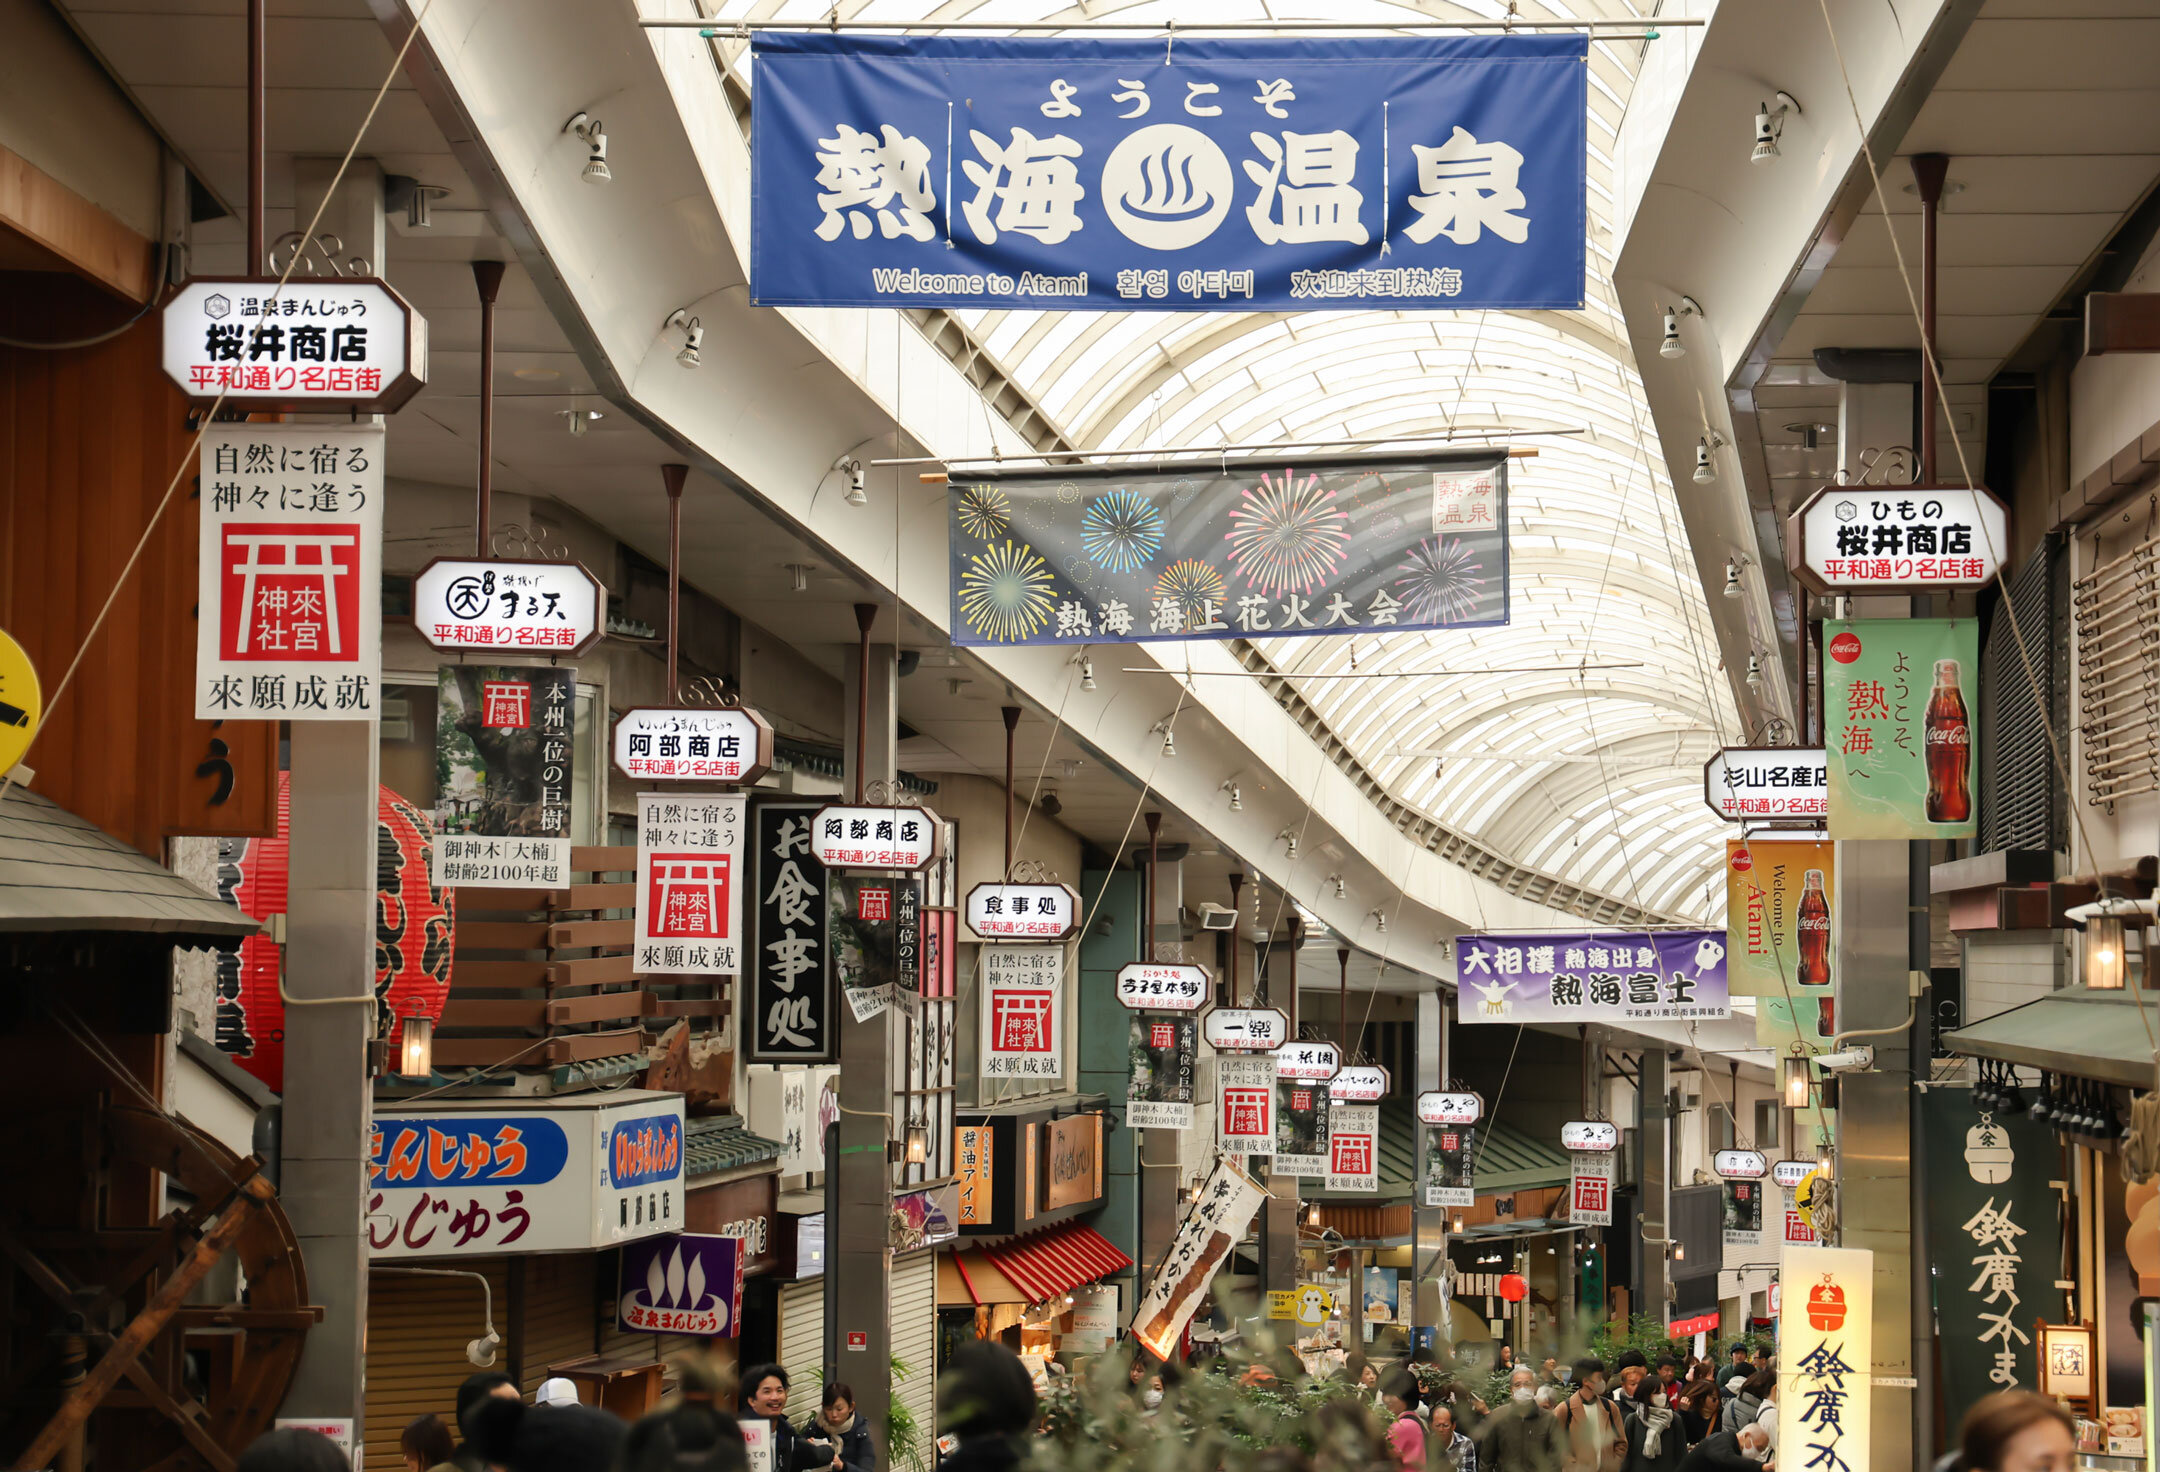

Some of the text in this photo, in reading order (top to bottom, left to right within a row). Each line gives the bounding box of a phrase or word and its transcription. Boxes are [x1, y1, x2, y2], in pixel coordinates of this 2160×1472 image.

[1041, 77, 1296, 120] ようこそ
[814, 124, 1532, 246] 熱海 温泉
[872, 268, 1089, 297] Welcome to Atami
[1116, 267, 1255, 299] 환영 아타미
[1290, 267, 1463, 298] 欢迎来到热海
[240, 297, 368, 318] 温泉まんじゅう
[204, 323, 369, 363] 桜井商店
[188, 365, 382, 392] 平和通り名店街
[214, 443, 370, 475] 自然に宿る
[210, 483, 368, 513] 神々に逢う
[1438, 477, 1492, 501] 熱海
[1438, 502, 1493, 526] 温泉
[1871, 500, 1943, 521] ひもの
[1836, 523, 1972, 556] 桜井商店
[1824, 558, 1984, 580] 平和通り名店街
[500, 591, 567, 621] まる天
[1054, 588, 1404, 638] 熱海 海上花火大会
[256, 586, 289, 651] 神社
[433, 624, 576, 646] 平和通り名店街
[1829, 642, 1861, 655] Coca-Cola
[207, 673, 371, 710] 來願成就
[1892, 651, 1917, 758] ようこそ、
[540, 682, 567, 831] 本州一位の巨樹
[629, 734, 740, 757] 阿部商店
[628, 758, 740, 776] 平和通り名店街
[645, 804, 737, 824] 自然に宿る
[645, 828, 735, 847] 神々に逢う
[825, 818, 920, 842] 阿部商店
[443, 840, 558, 861] 御神木「大楠」
[823, 848, 919, 865] 平和通り名店街
[443, 861, 559, 883] 樹齢2100年超
[668, 891, 687, 932] 神社
[984, 895, 1057, 915] 食事処
[1773, 864, 1786, 946] Welcome to
[764, 815, 820, 1046] お食事処
[899, 888, 915, 987] 本州一位の巨樹
[978, 920, 1062, 935] 平和通り名店街
[640, 945, 735, 969] 來願成就
[989, 954, 1057, 969] 自然に宿る
[1463, 945, 1656, 975] 大相撲 熱海出身
[988, 971, 1056, 986] 神々に逢う
[1143, 969, 1181, 979] おかき処
[1123, 978, 1200, 998] 寺子屋本舗
[1550, 972, 1697, 1006] 熱海富士
[1128, 997, 1195, 1008] 平和通り名店街
[1625, 1007, 1726, 1018] 平和通り商店街振興組合
[1214, 1038, 1275, 1048] 平和通り名店街
[1179, 1024, 1193, 1100] 本州一位の巨樹
[1221, 1061, 1272, 1072] 自然に宿る
[1221, 1074, 1272, 1085] 神々に逢う
[1316, 1090, 1326, 1153] 本州一位の巨樹
[1329, 1123, 1374, 1132] 神々に逢う
[1330, 1111, 1375, 1120] 自然に宿る
[1424, 1114, 1473, 1122] 平和通り名店街
[1567, 1141, 1611, 1149] 平和通り名店街
[627, 1305, 717, 1331] 温泉まんじゅう
